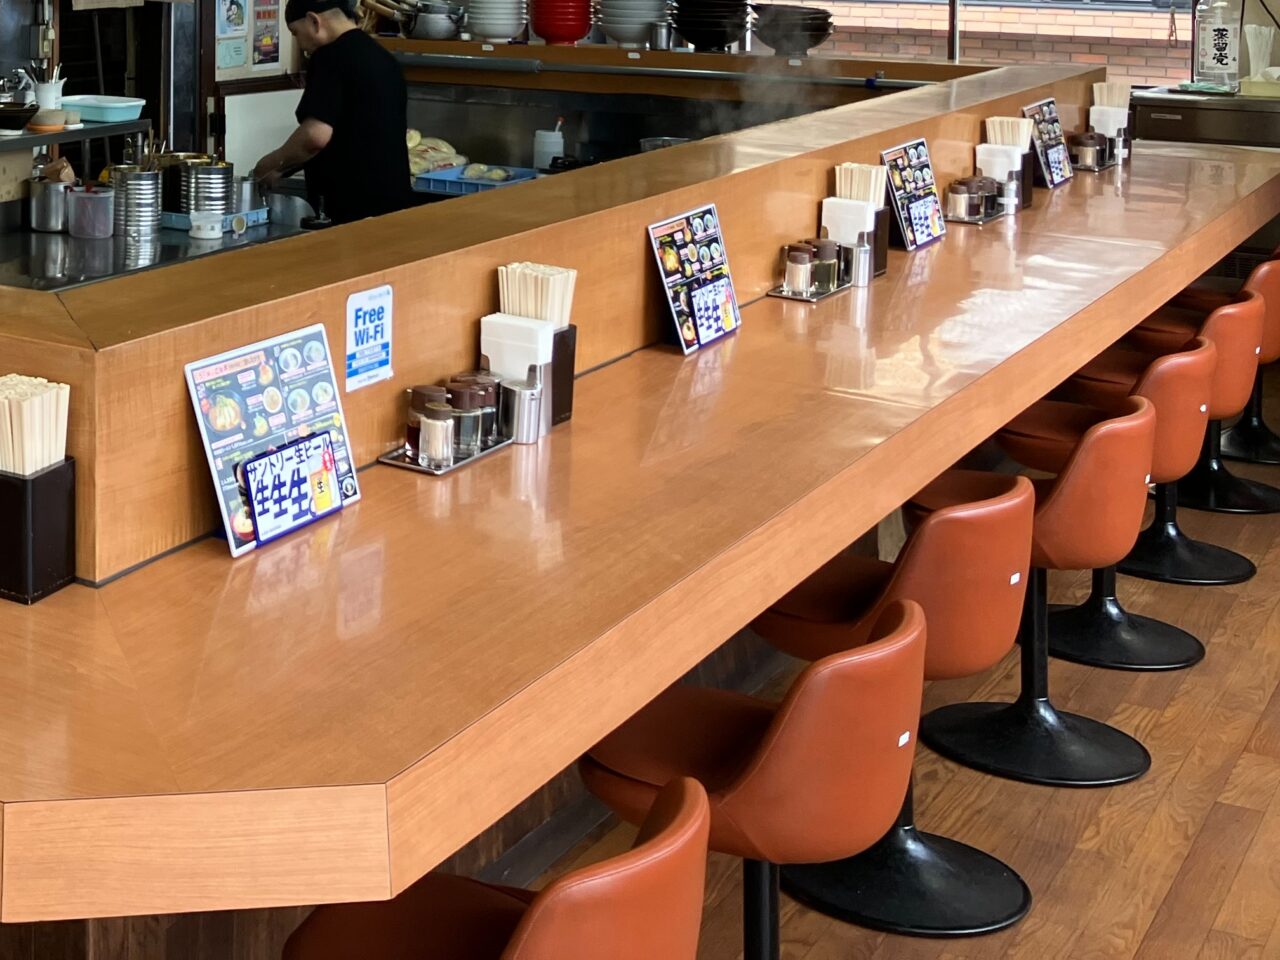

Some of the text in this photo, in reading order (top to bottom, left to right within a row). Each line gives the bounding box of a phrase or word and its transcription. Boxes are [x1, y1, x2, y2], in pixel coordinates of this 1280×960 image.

[354, 305, 385, 328] Free
[354, 323, 384, 347] Wi-Fi
[247, 436, 334, 483] サントリー生ビール
